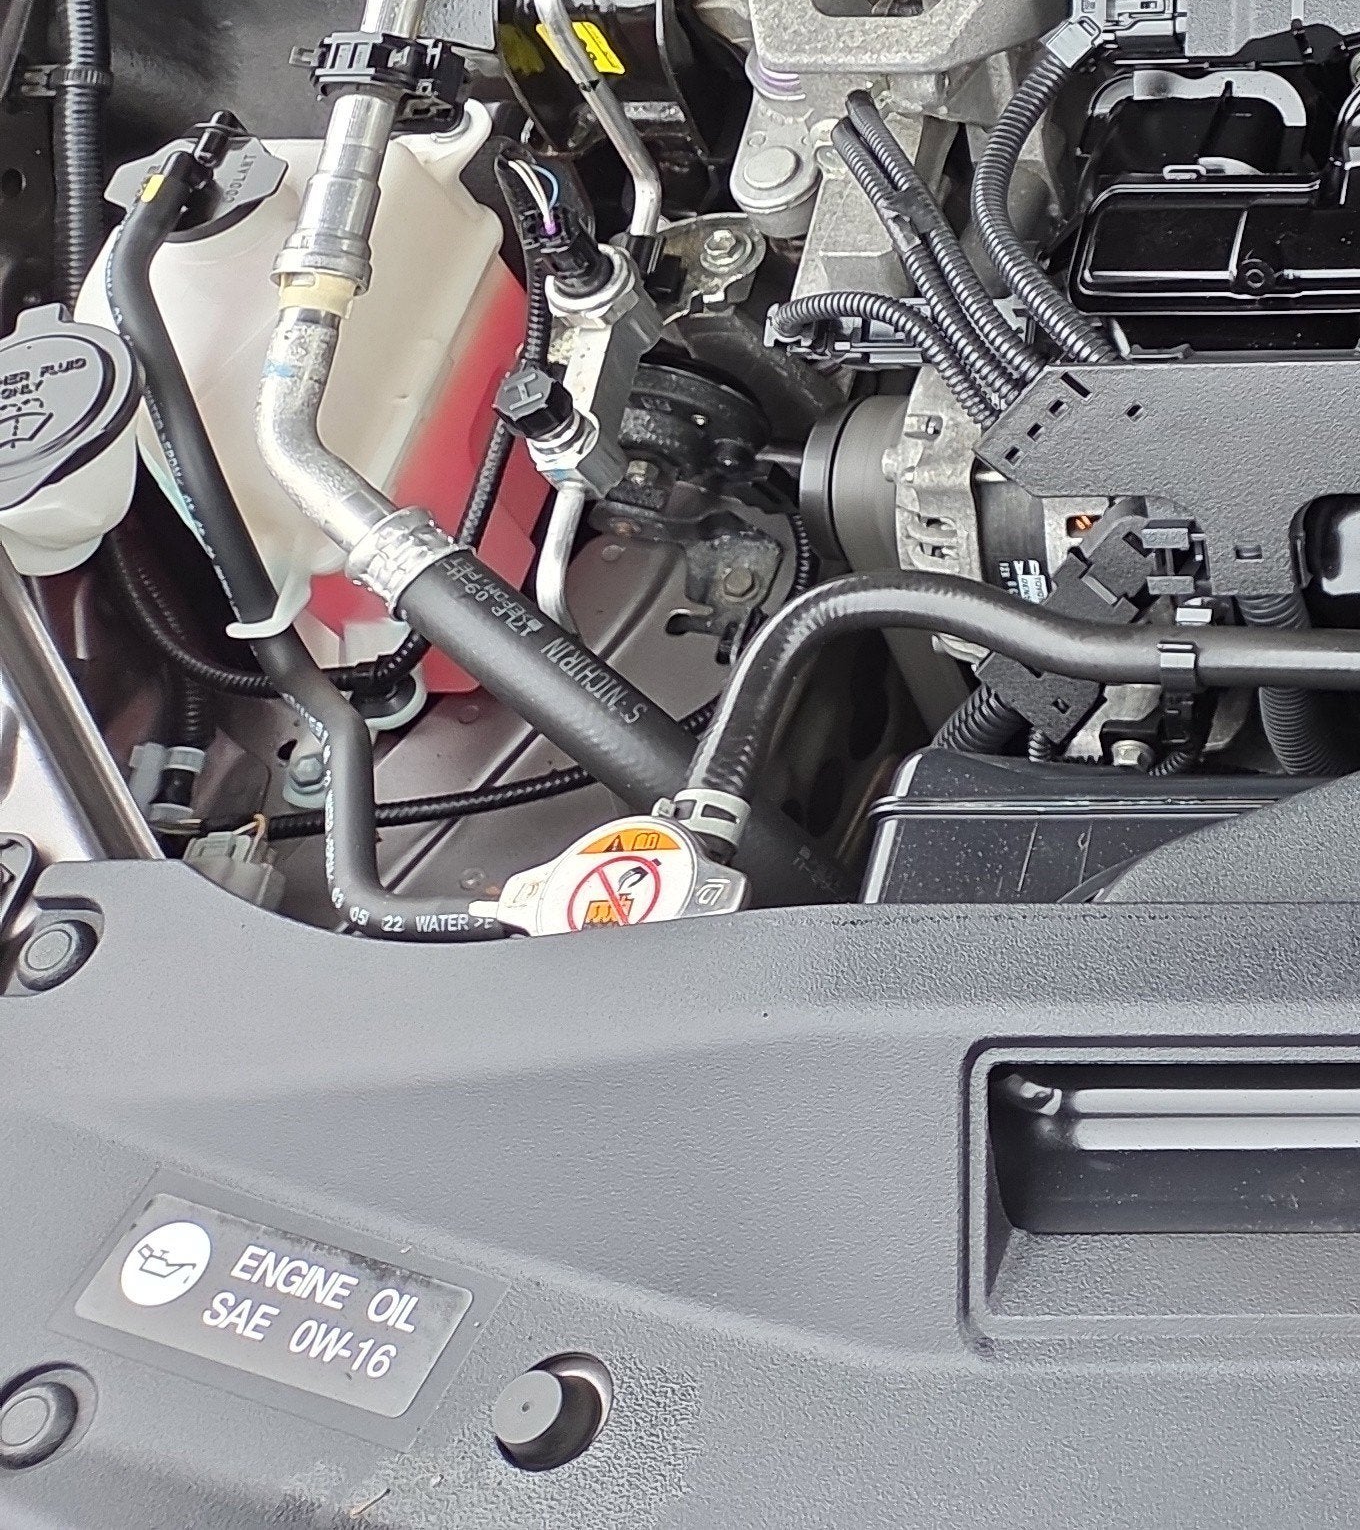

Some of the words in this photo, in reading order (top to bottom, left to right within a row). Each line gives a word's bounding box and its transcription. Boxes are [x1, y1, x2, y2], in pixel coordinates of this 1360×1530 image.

[40, 357, 87, 378] FLUID
[415, 913, 470, 933] WATER
[230, 1245, 359, 1310] ENGINE
[366, 1288, 419, 1333] OIL
[202, 1291, 281, 1341] SAE
[288, 1319, 397, 1379] 0W-16
